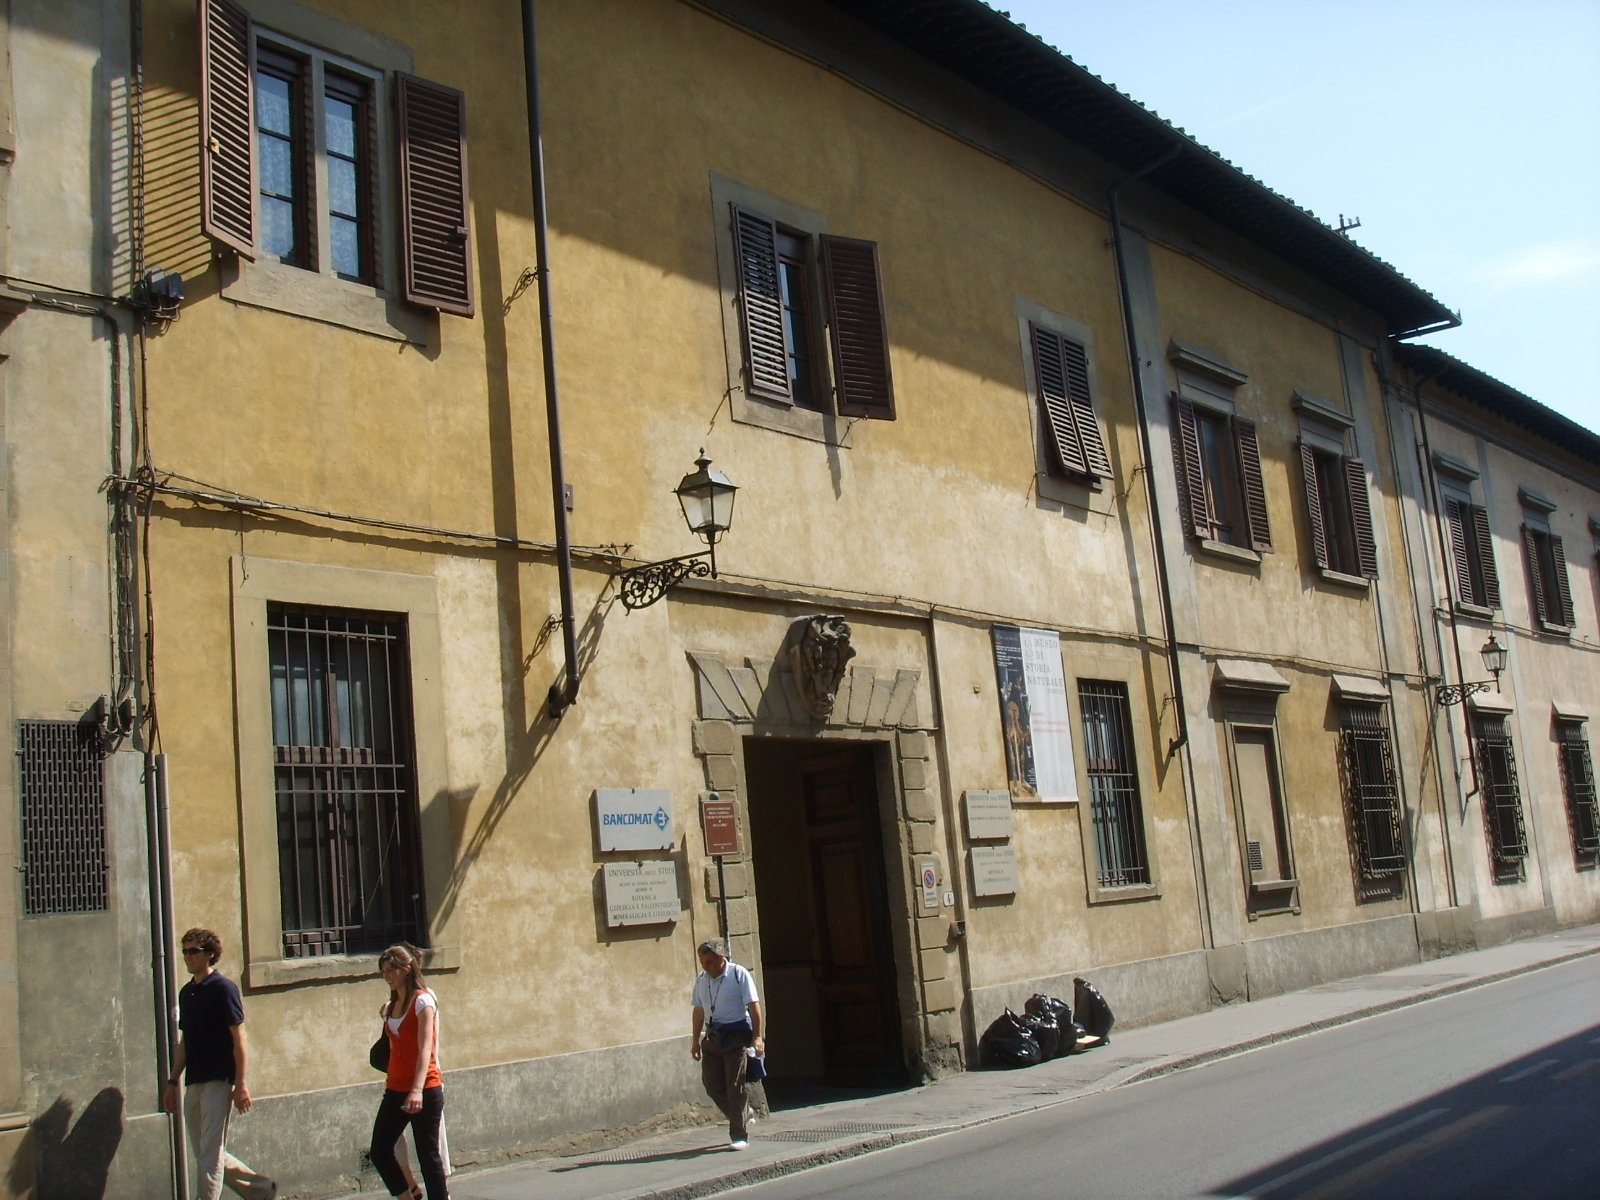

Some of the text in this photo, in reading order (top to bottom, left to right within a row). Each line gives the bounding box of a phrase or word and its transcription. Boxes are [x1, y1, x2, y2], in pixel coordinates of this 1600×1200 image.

[1033, 638, 1058, 649] MUSEO
[1025, 662, 1050, 674] STORIA
[1027, 675, 1063, 688] NATURALE
[603, 813, 652, 826] BANCOMAT
